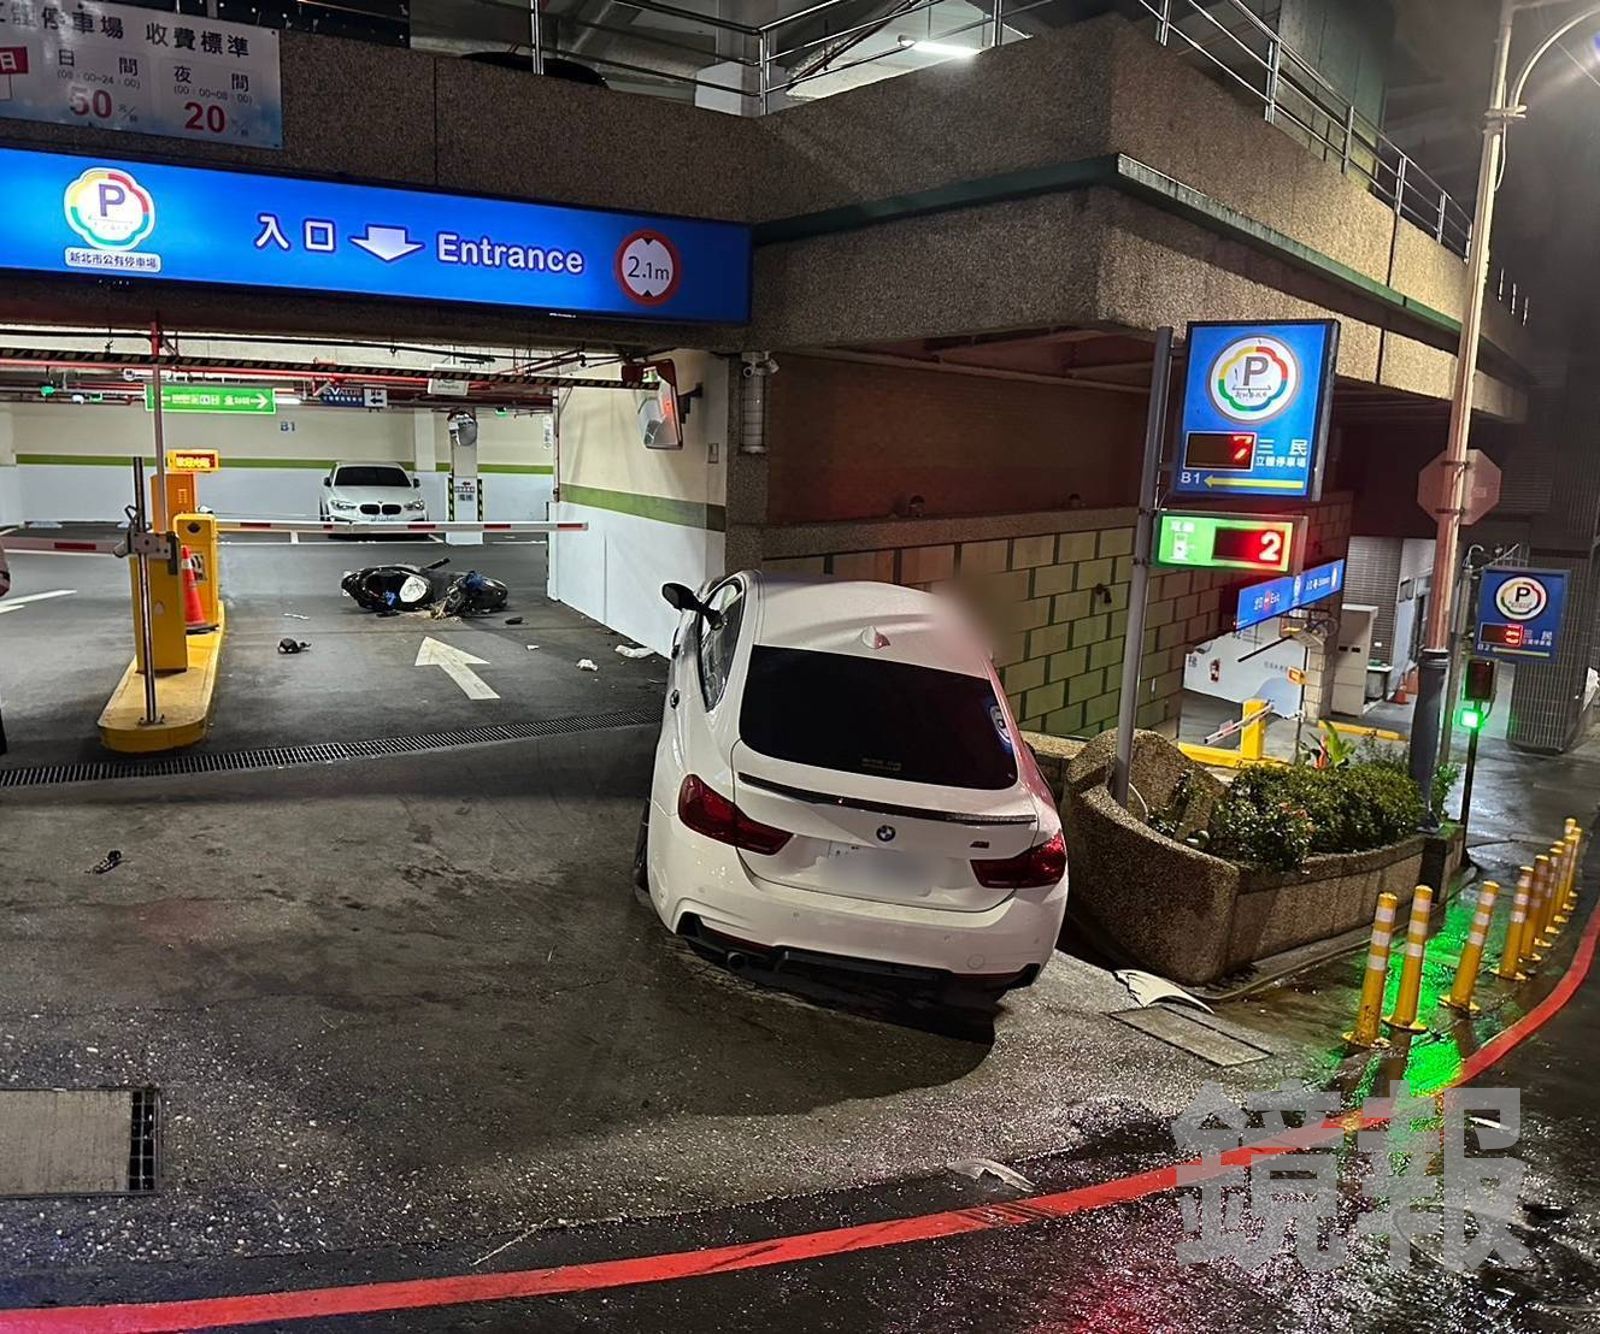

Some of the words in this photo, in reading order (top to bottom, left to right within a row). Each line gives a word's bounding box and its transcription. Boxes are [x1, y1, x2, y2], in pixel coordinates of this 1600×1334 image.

[145, 21, 250, 58] 收費標準
[69, 84, 112, 119] 50
[184, 102, 225, 133] 20
[98, 183, 126, 218] P
[256, 214, 336, 252] 入口
[69, 250, 158, 269] 新北市公有停車場
[437, 232, 584, 274] Entrance
[627, 255, 670, 281] 2.1m
[1243, 355, 1269, 387] P
[280, 420, 296, 432] B1
[1256, 438, 1308, 457] 三民
[1180, 471, 1201, 484] B1
[1258, 530, 1282, 561] 2
[1515, 586, 1531, 602] P
